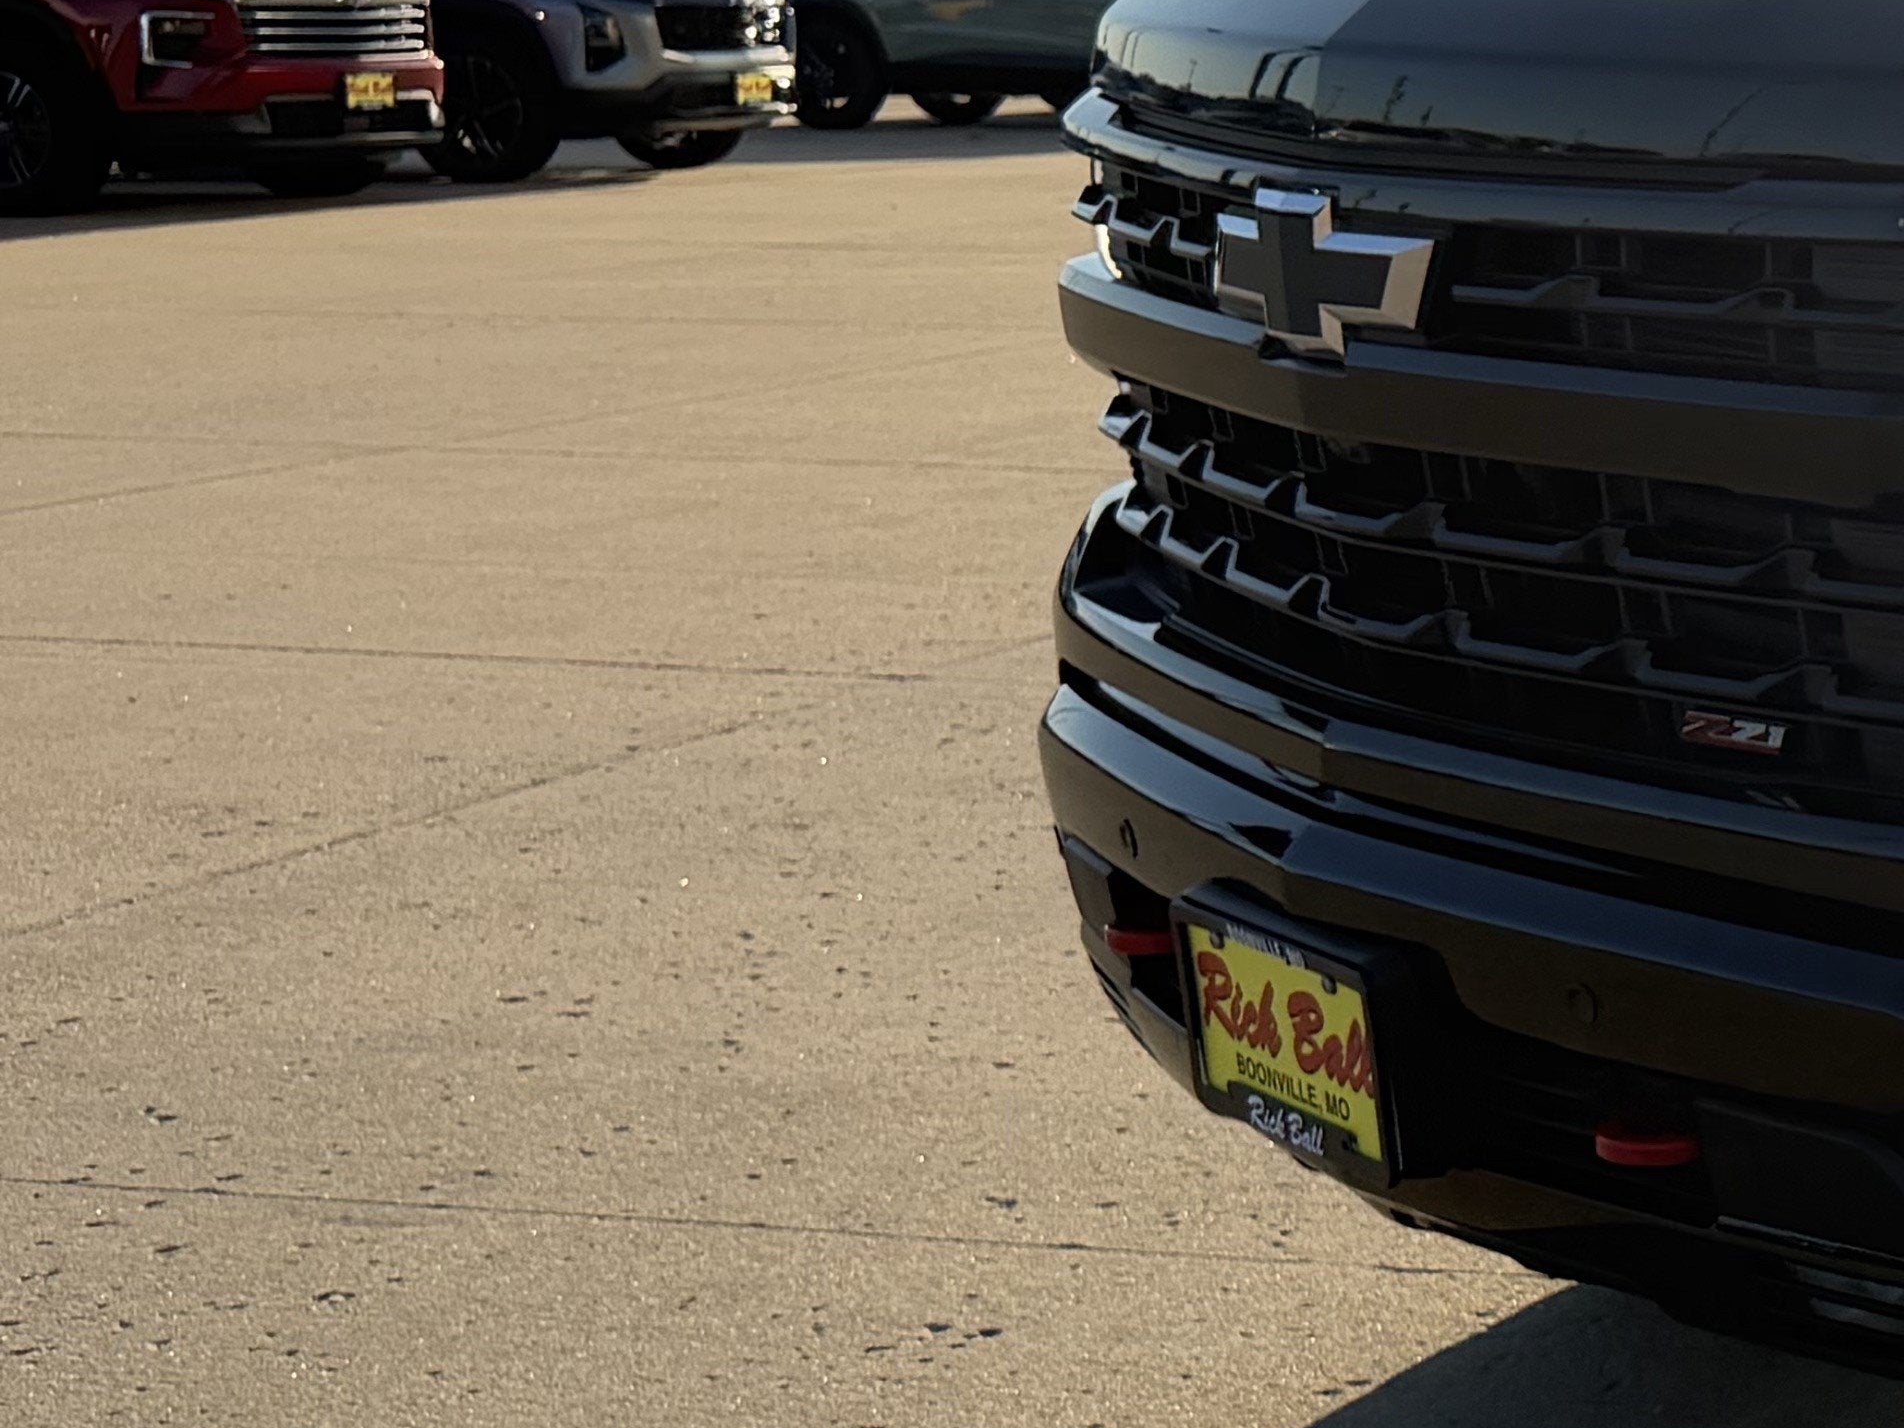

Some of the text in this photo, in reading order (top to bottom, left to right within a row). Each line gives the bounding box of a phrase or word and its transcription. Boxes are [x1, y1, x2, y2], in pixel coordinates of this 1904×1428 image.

[1681, 709, 1787, 756] Z71
[1198, 952, 1375, 1099] Rick Ball
[1237, 1053, 1351, 1121] BOONVILLE, MO
[1247, 1094, 1325, 1157] Rick Ball
